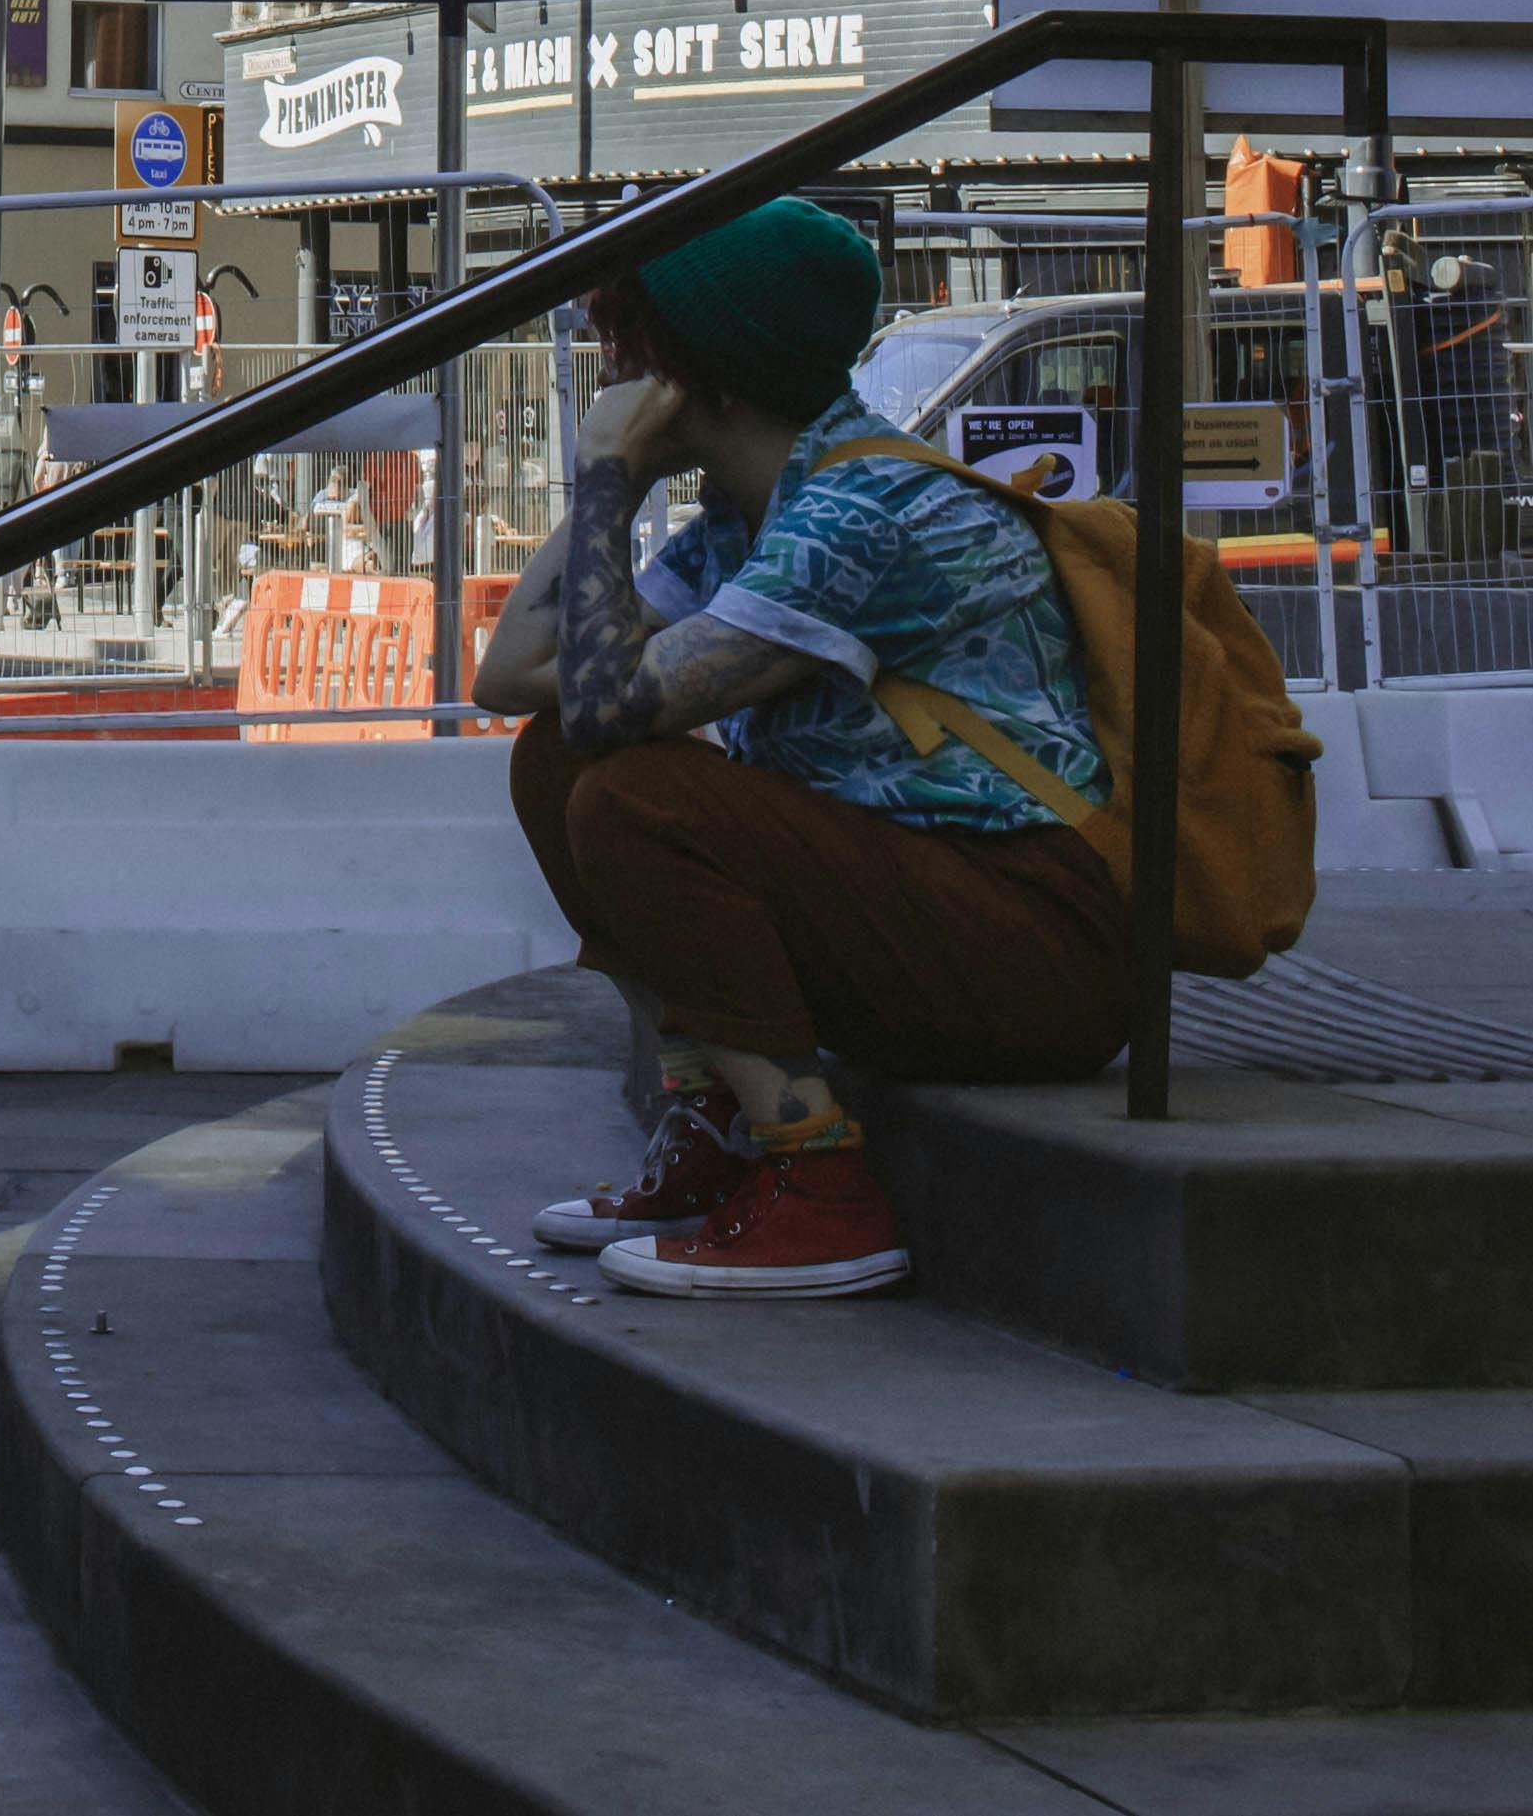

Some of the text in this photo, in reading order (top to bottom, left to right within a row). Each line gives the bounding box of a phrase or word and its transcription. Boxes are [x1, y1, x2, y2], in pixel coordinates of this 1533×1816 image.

[633, 14, 865, 77] SOFT SERVE
[482, 46, 498, 92] &
[504, 36, 572, 90] MASH
[277, 70, 387, 135] PIEMINISTER
[151, 168, 168, 179] taxi
[135, 203, 150, 213] am
[160, 202, 172, 213] 10
[175, 204, 191, 215] am
[128, 217, 135, 228] 4
[138, 219, 155, 231] pm
[163, 218, 170, 230] 7
[172, 220, 188, 232] pm
[140, 296, 176, 310] Traffic
[123, 314, 192, 326] enforcement
[135, 331, 181, 342] cameras
[968, 420, 1034, 430] WE'RE OPEN
[1194, 420, 1259, 430] businesses
[1183, 439, 1205, 449] pen
[1226, 436, 1258, 447] usual
